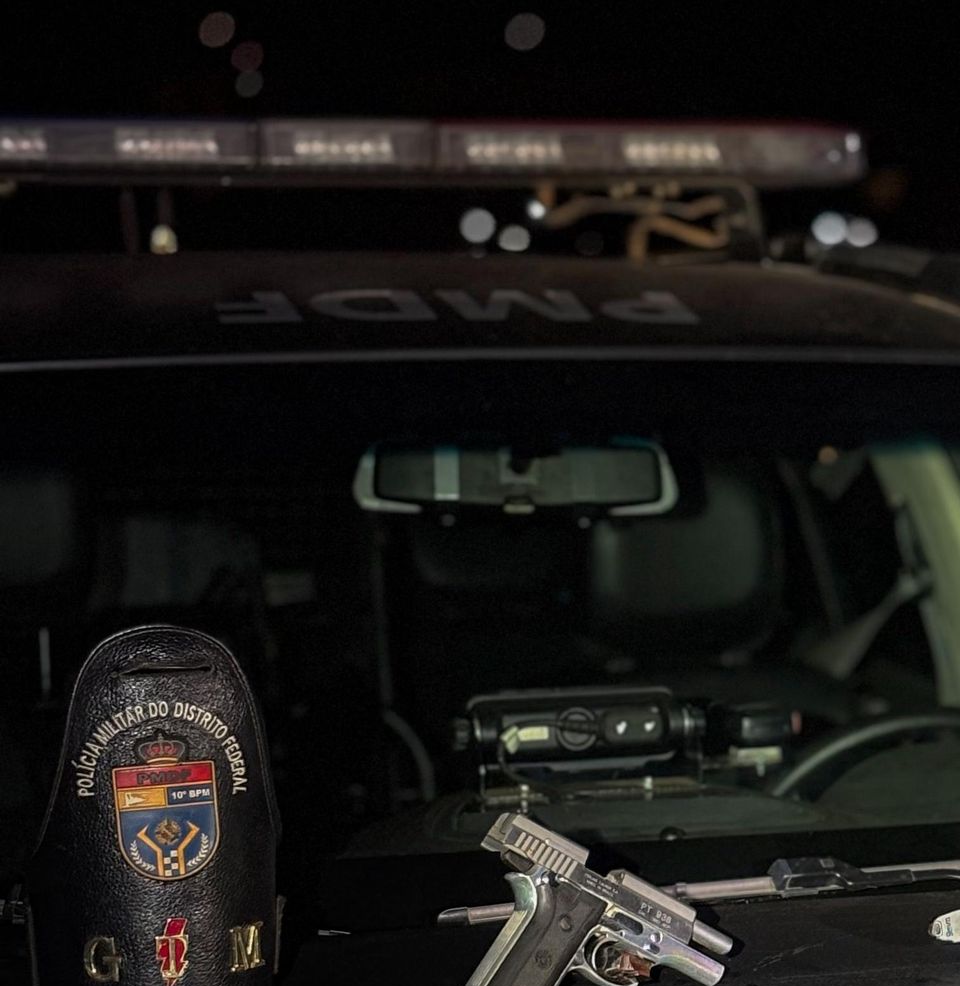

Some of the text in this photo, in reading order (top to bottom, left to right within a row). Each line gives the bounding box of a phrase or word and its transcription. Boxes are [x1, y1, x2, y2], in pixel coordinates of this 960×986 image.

[214, 289, 700, 324] PMDF
[71, 701, 248, 797] POLÍCIA MILITAR DO DISTRITO FEDERAL
[189, 788, 210, 799] BPM
[640, 902, 654, 914] PT
